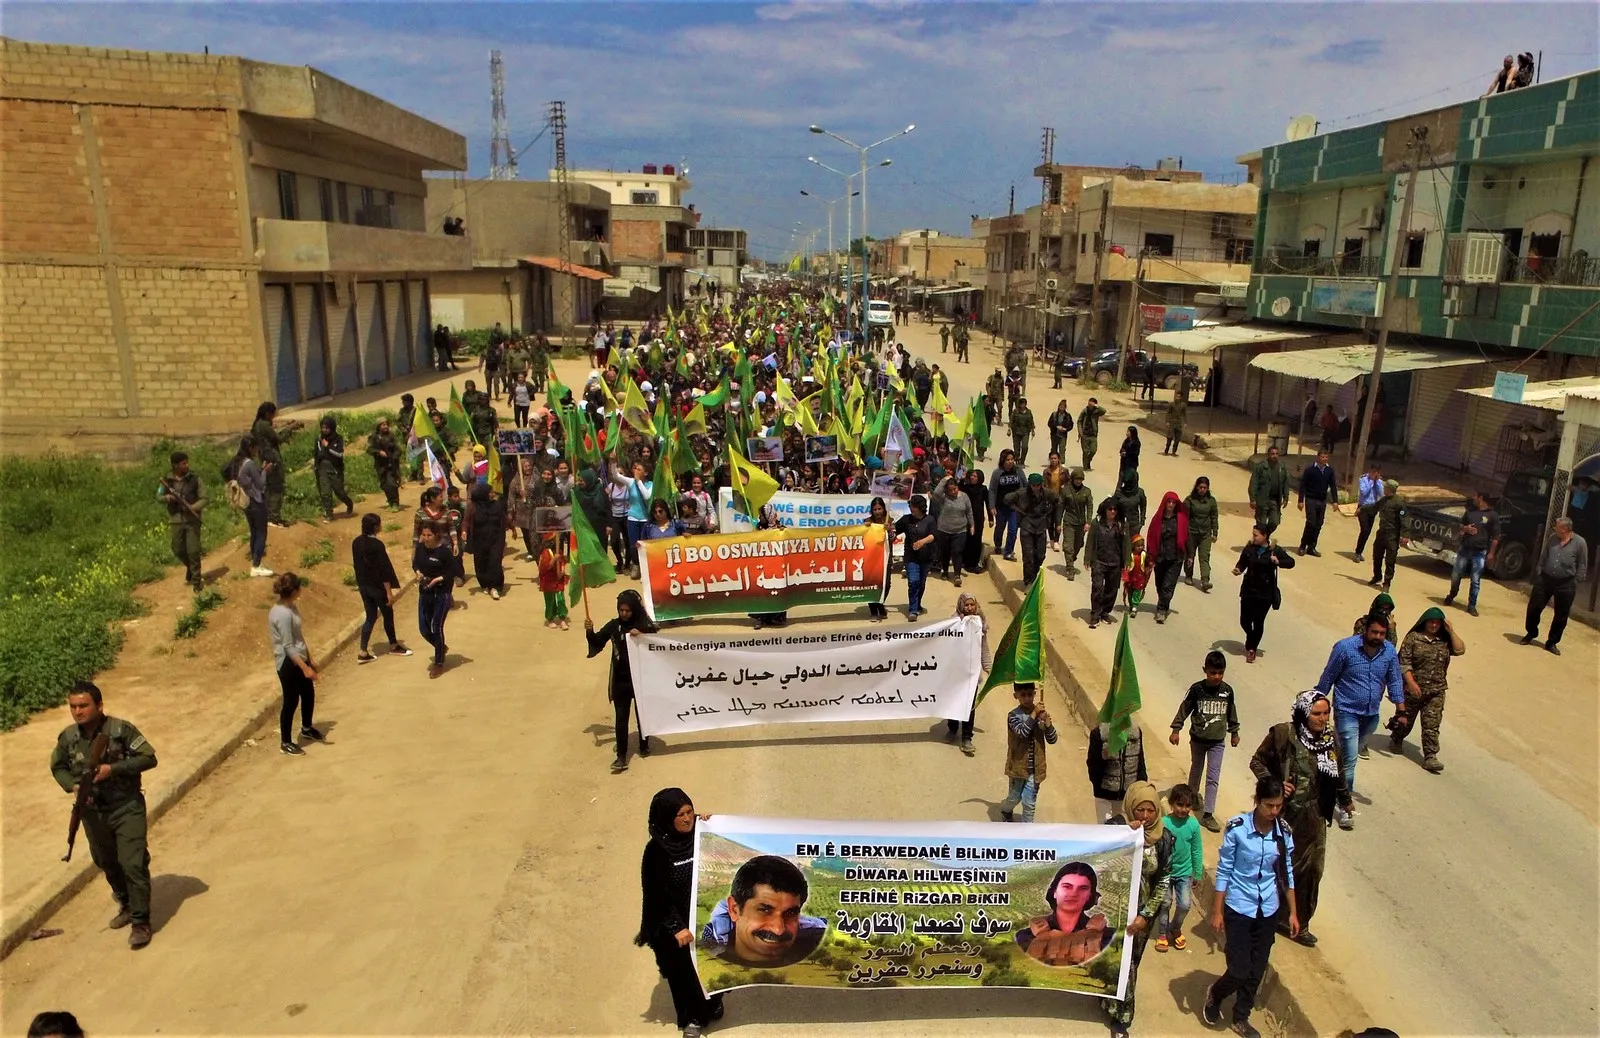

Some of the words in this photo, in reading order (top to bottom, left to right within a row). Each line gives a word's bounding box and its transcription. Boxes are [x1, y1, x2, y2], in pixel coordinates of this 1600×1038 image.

[799, 505, 831, 515] BIBE
[1409, 517, 1453, 538] TOYOTA
[666, 544, 682, 568] JÎ
[685, 545, 713, 563] BO
[717, 538, 810, 560] OSMANIYA
[814, 533, 838, 552] NÛ
[841, 535, 865, 551] NA
[756, 559, 846, 596] للعثمانية
[852, 557, 864, 581] لا
[669, 566, 751, 600] الجديدة
[669, 641, 726, 652] bêdengiya
[786, 634, 828, 645] derbarê
[831, 632, 862, 642] Efrînê
[866, 632, 882, 641] de;
[885, 631, 936, 642] Şermezar
[938, 628, 964, 638] dikin
[733, 667, 774, 686] حيال
[780, 664, 831, 690] الدولي
[835, 659, 897, 677] الصمت
[901, 655, 938, 677] ندين
[675, 667, 728, 689] عفرين
[796, 844, 820, 856] EM
[825, 841, 836, 857] Ê
[840, 844, 951, 859] BERXWEDANÊ
[845, 865, 908, 881] DÎWARA
[840, 888, 898, 904] EFRÎNÊ
[836, 909, 905, 939] المقاومة
[913, 912, 965, 934] نصعد
[970, 909, 1011, 938] سوف
[860, 943, 915, 960] السور
[921, 942, 982, 959] ونحطم
[847, 961, 909, 983] عفرين
[912, 959, 983, 979] وسنحرر
